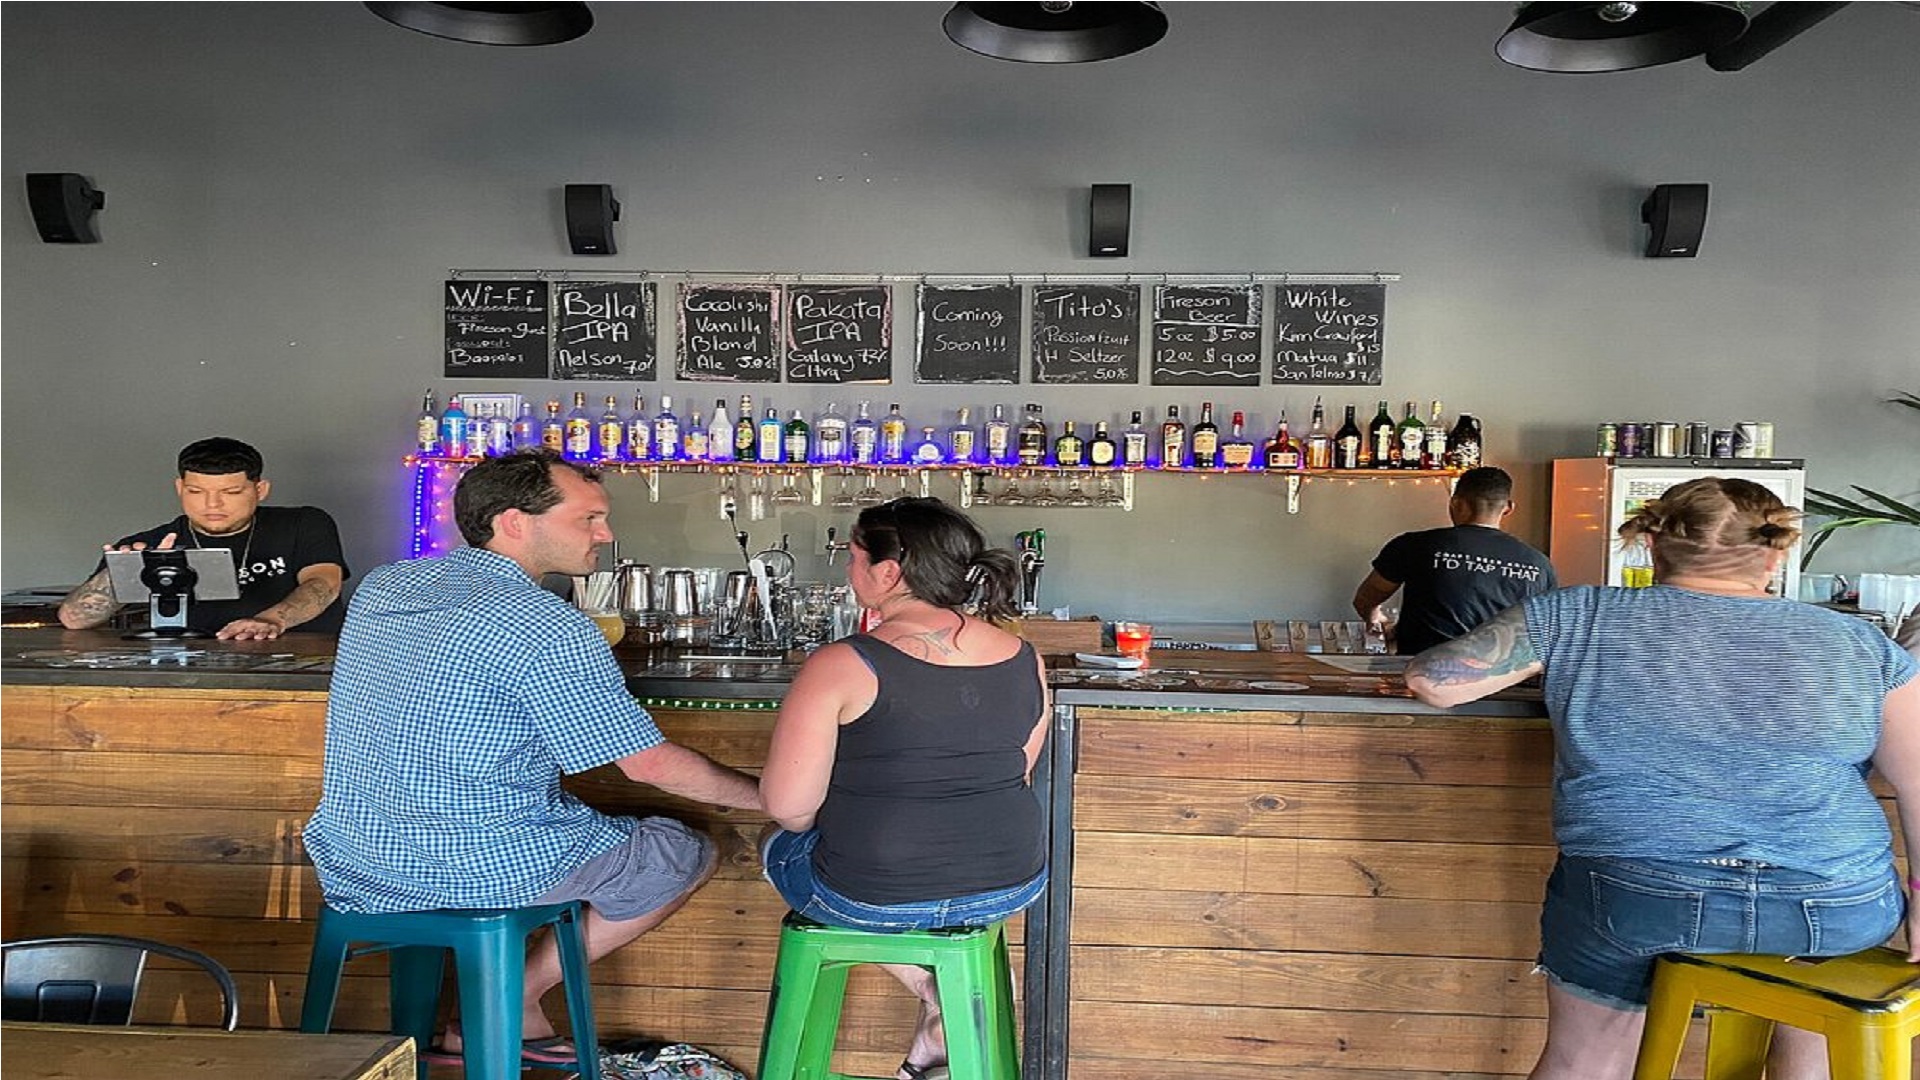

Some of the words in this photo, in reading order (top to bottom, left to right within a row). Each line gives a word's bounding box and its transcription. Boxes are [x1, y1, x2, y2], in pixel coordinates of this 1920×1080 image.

[449, 283, 535, 306] Wi-Fi
[564, 291, 636, 319] Bella
[1160, 289, 1231, 309] Fireson
[1286, 287, 1352, 308] White
[796, 294, 881, 319] Pakata
[932, 301, 1004, 328] Coming
[1043, 292, 1123, 319] Tito's
[1315, 310, 1379, 327] Wines
[562, 320, 629, 345] IPA
[797, 320, 862, 345] IPA
[933, 333, 1006, 352] Soon!!!
[691, 335, 757, 352] Blond
[560, 349, 622, 367] Nelson
[696, 354, 726, 370] Ale
[1044, 349, 1058, 363] H
[1069, 346, 1126, 363] Seltzer
[1465, 560, 1496, 573] TAP
[1501, 566, 1540, 581] THAT
